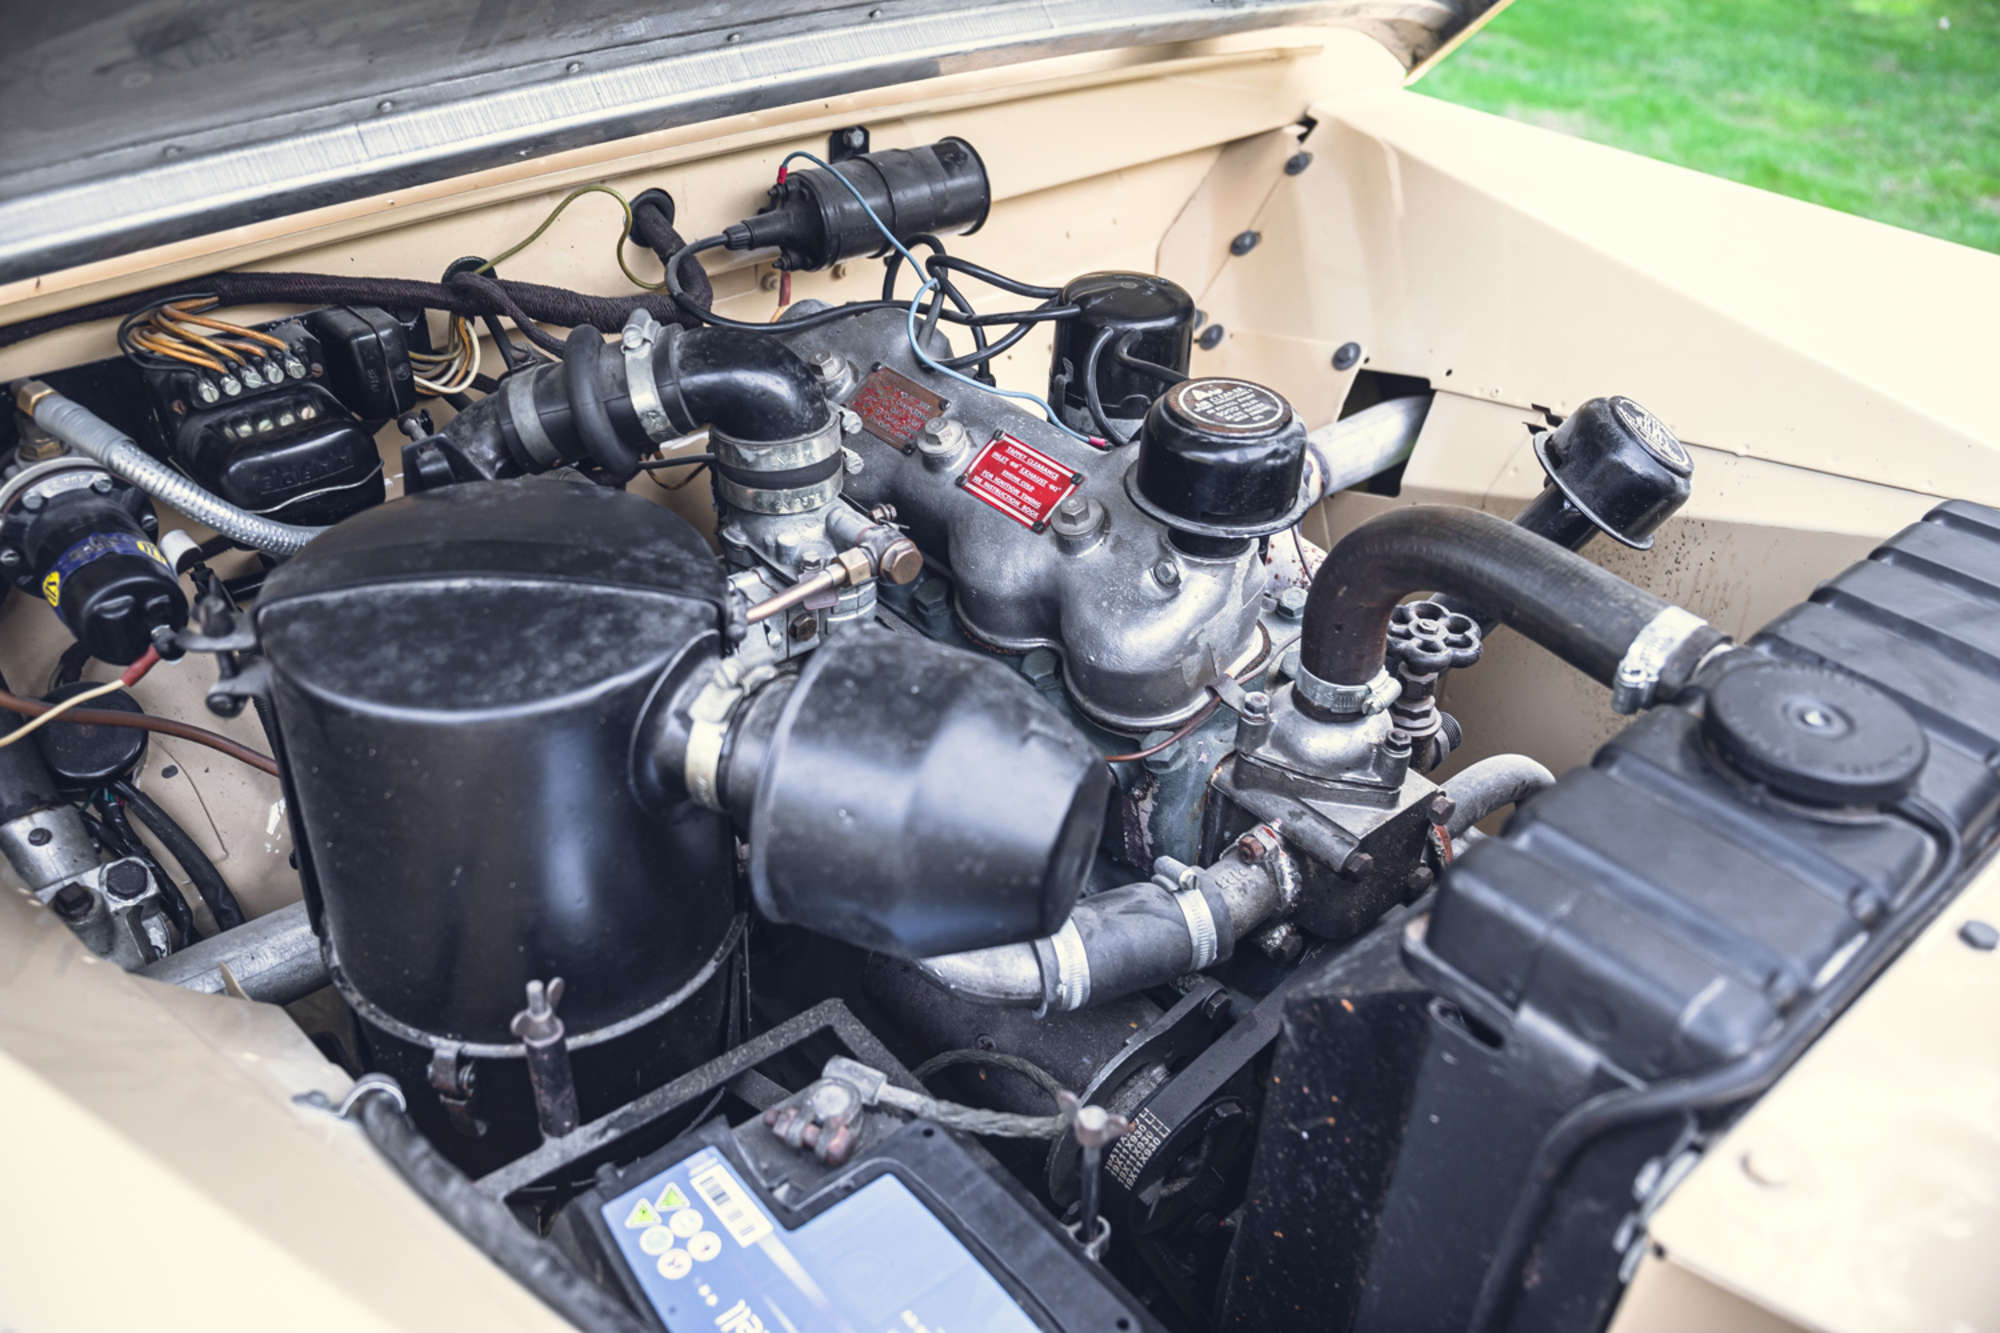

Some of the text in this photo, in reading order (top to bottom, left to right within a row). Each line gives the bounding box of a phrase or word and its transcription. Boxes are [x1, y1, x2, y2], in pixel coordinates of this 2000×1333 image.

[991, 450, 1010, 465] INLET
[1018, 467, 1049, 487] EXHAUST
[1006, 446, 1060, 481] TAPPET CLEARANCE
[981, 469, 1042, 509] FOR IGNITION TIMING
[982, 481, 1021, 507] INSTRUCTION
[1021, 504, 1040, 519] BOOK
